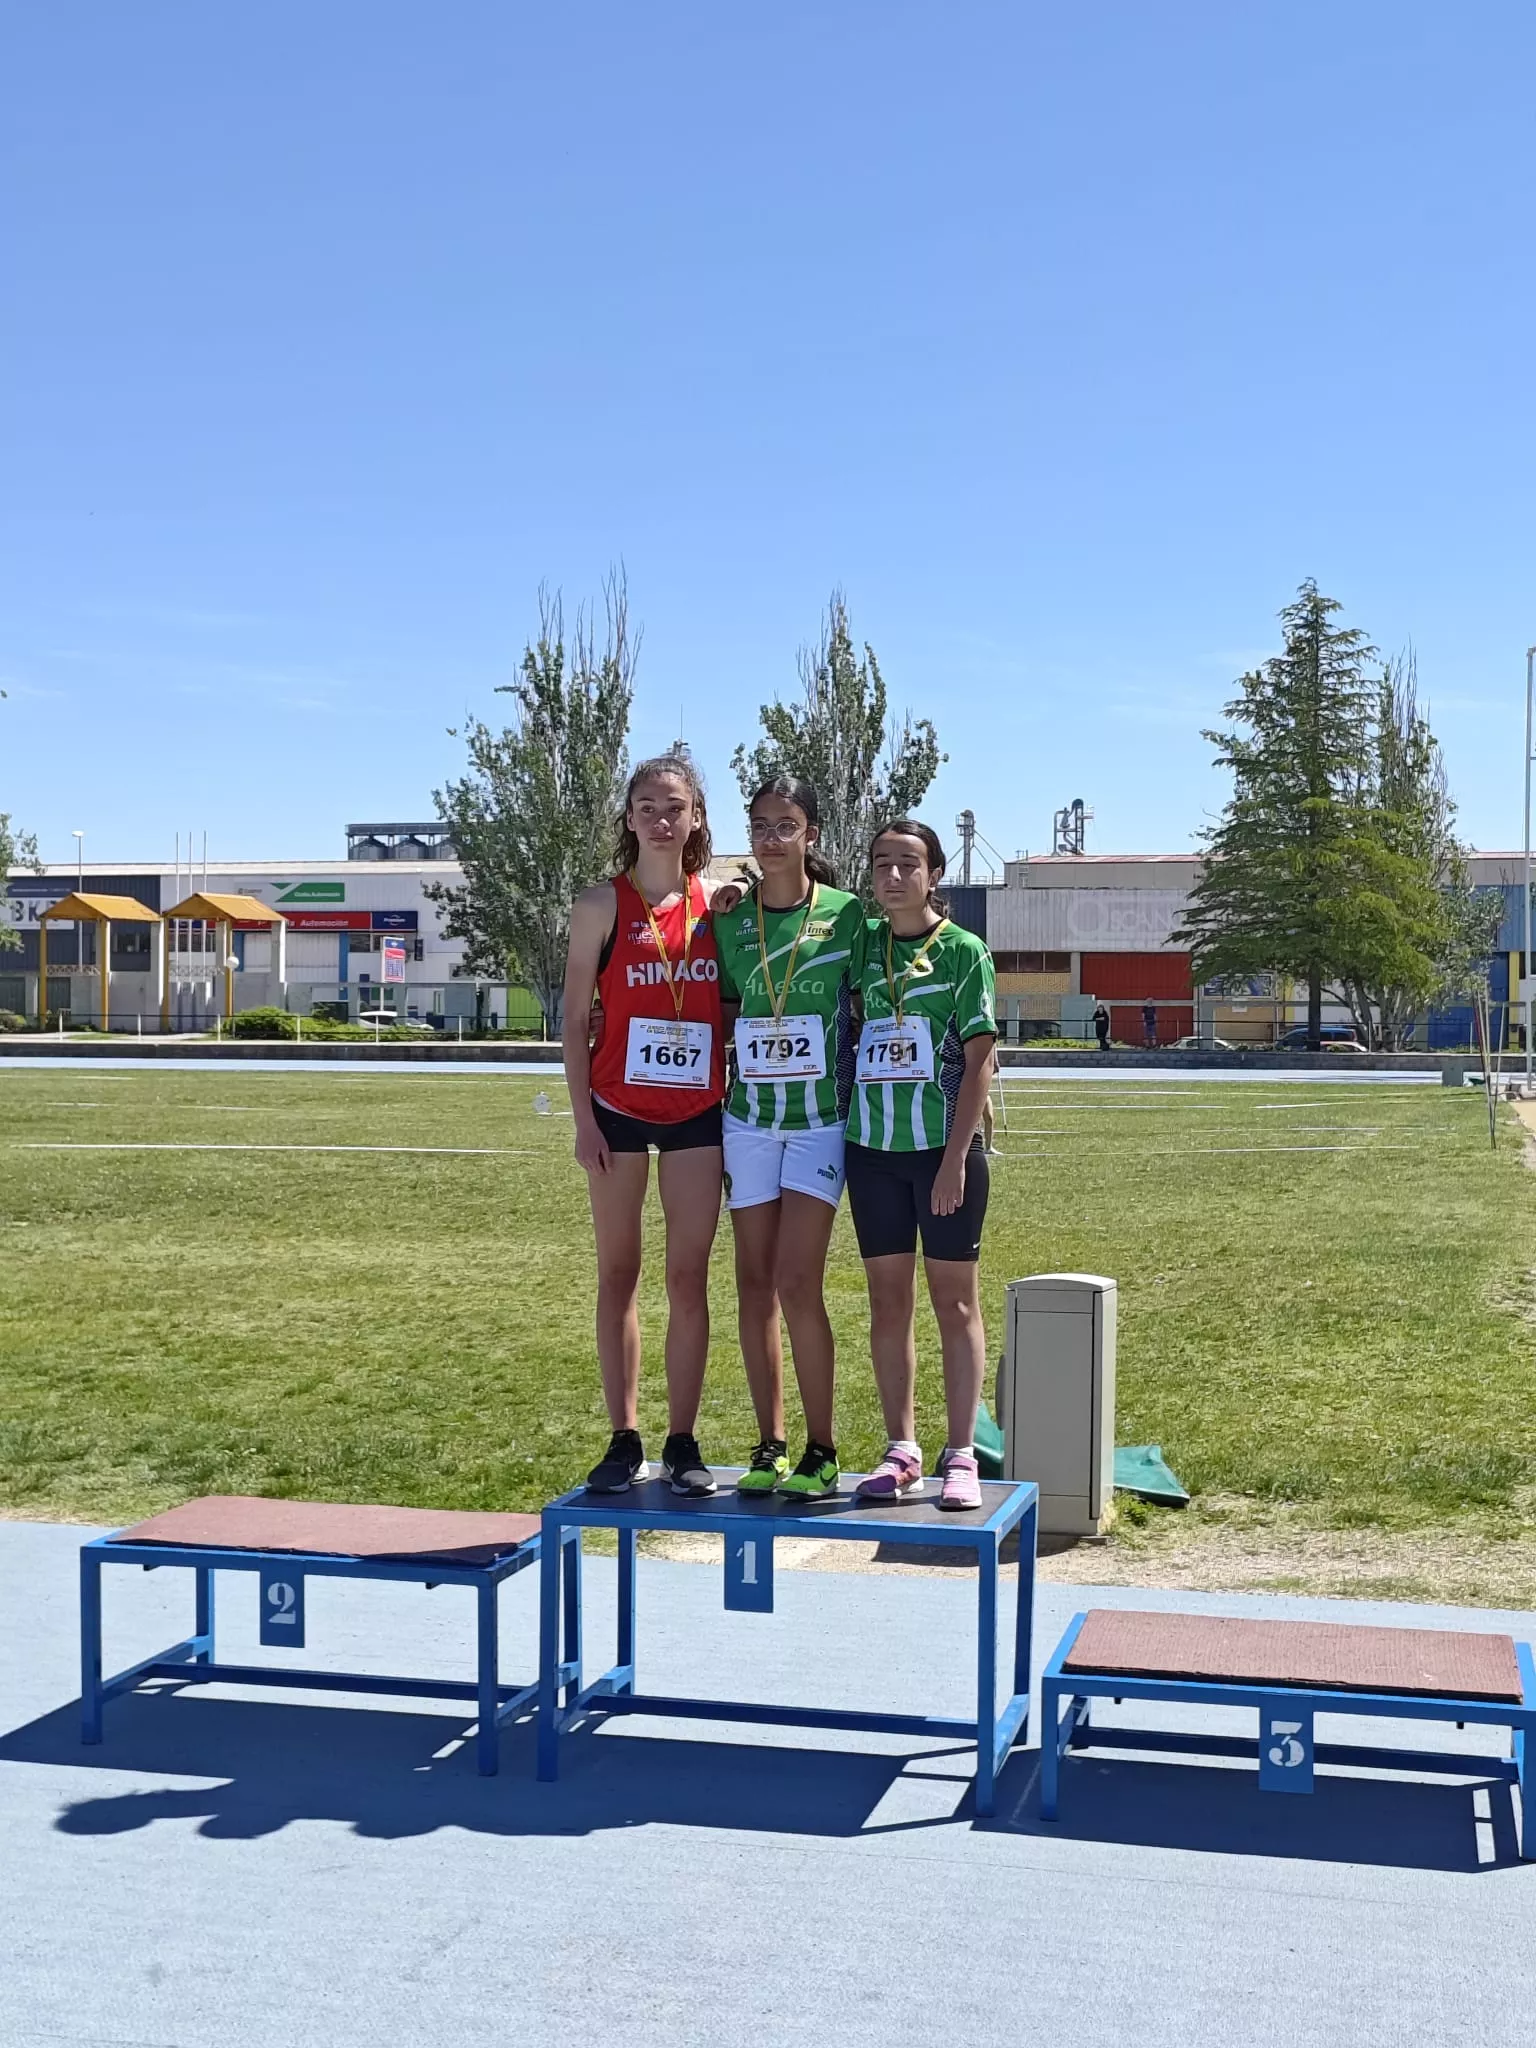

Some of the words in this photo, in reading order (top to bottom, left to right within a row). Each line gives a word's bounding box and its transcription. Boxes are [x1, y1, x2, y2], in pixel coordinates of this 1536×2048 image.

[626, 958, 718, 988] HINACO
[639, 1044, 702, 1068] 1667
[747, 1037, 811, 1060] 1792
[866, 1042, 917, 1064] 1791
[736, 1540, 759, 1585] 1
[267, 1582, 296, 1625] 2
[1268, 1720, 1305, 1768] 3
